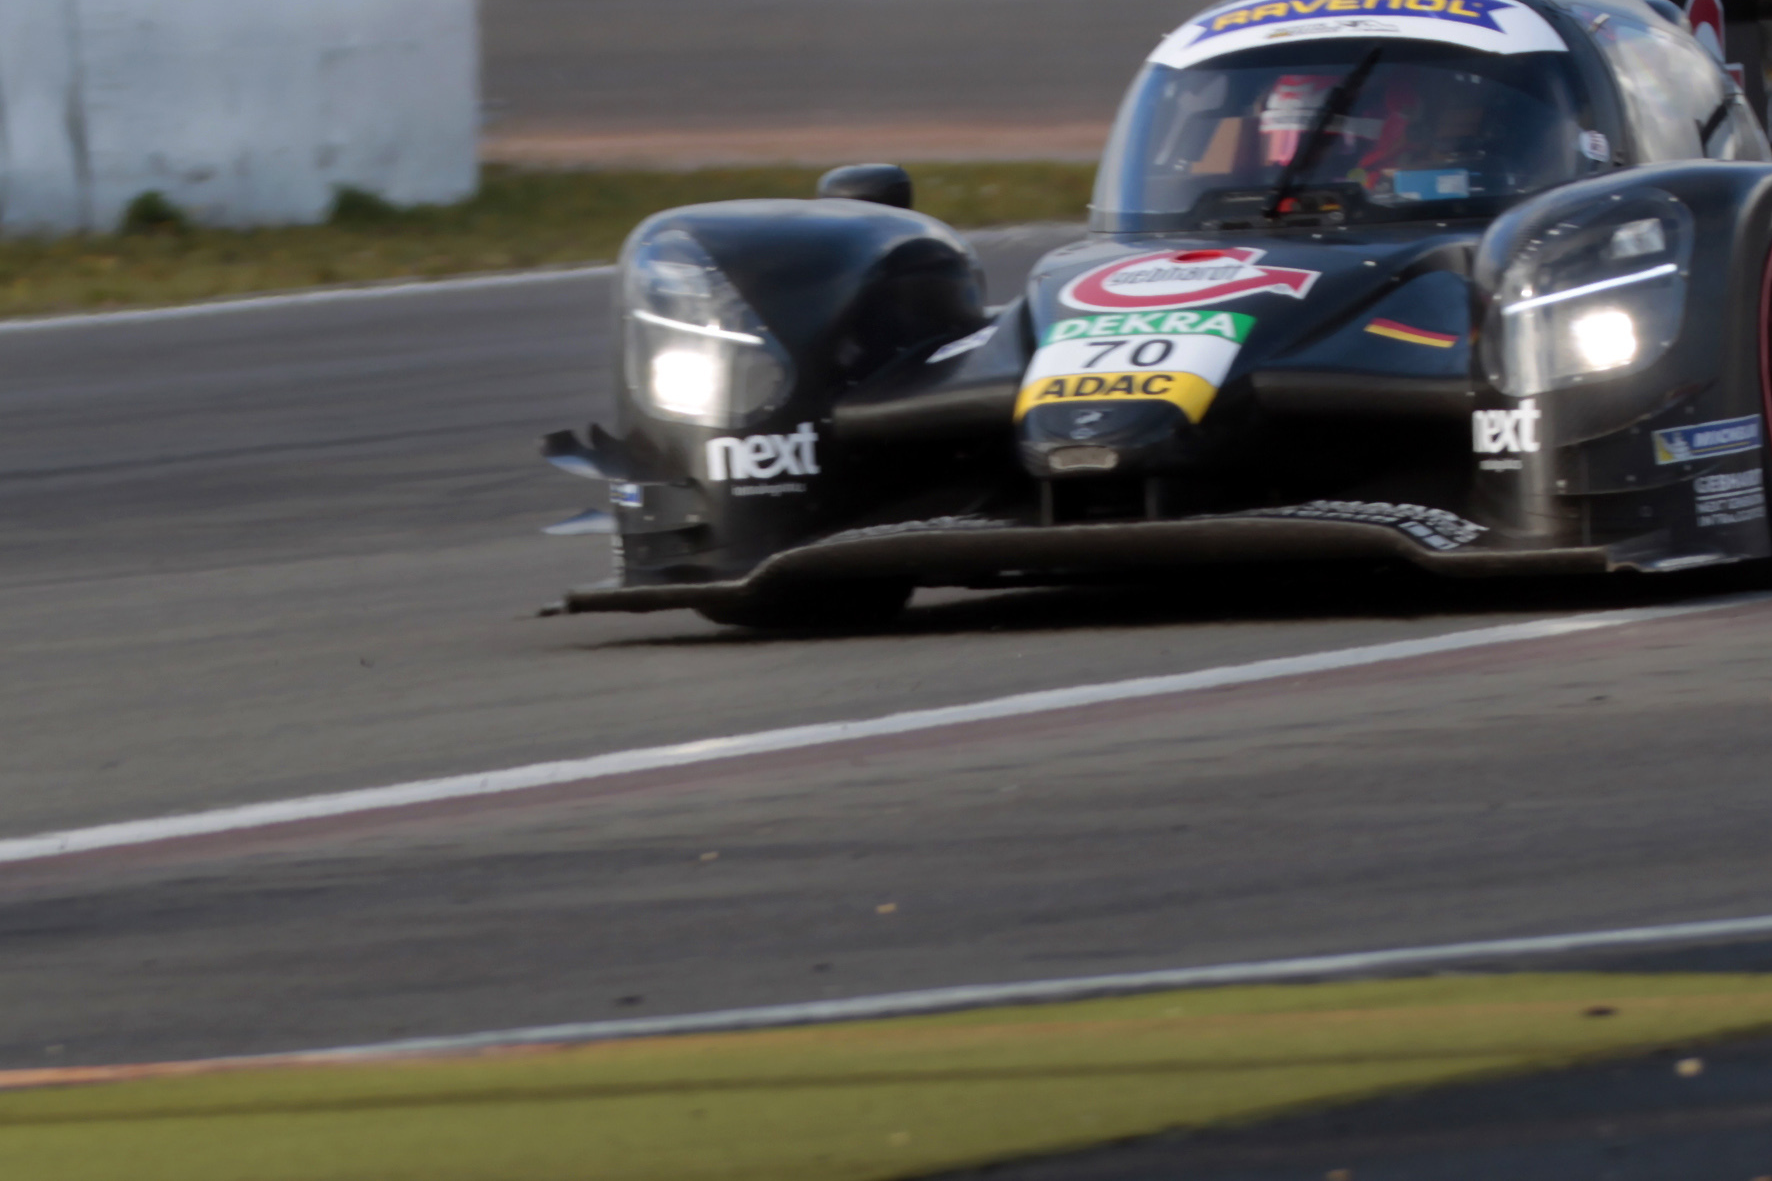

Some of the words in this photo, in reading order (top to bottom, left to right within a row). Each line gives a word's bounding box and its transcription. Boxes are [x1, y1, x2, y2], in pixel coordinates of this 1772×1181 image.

[1050, 311, 1237, 342] DEKRA
[1082, 339, 1176, 369] 70
[1038, 373, 1175, 400] ADAC
[705, 421, 822, 481] next
